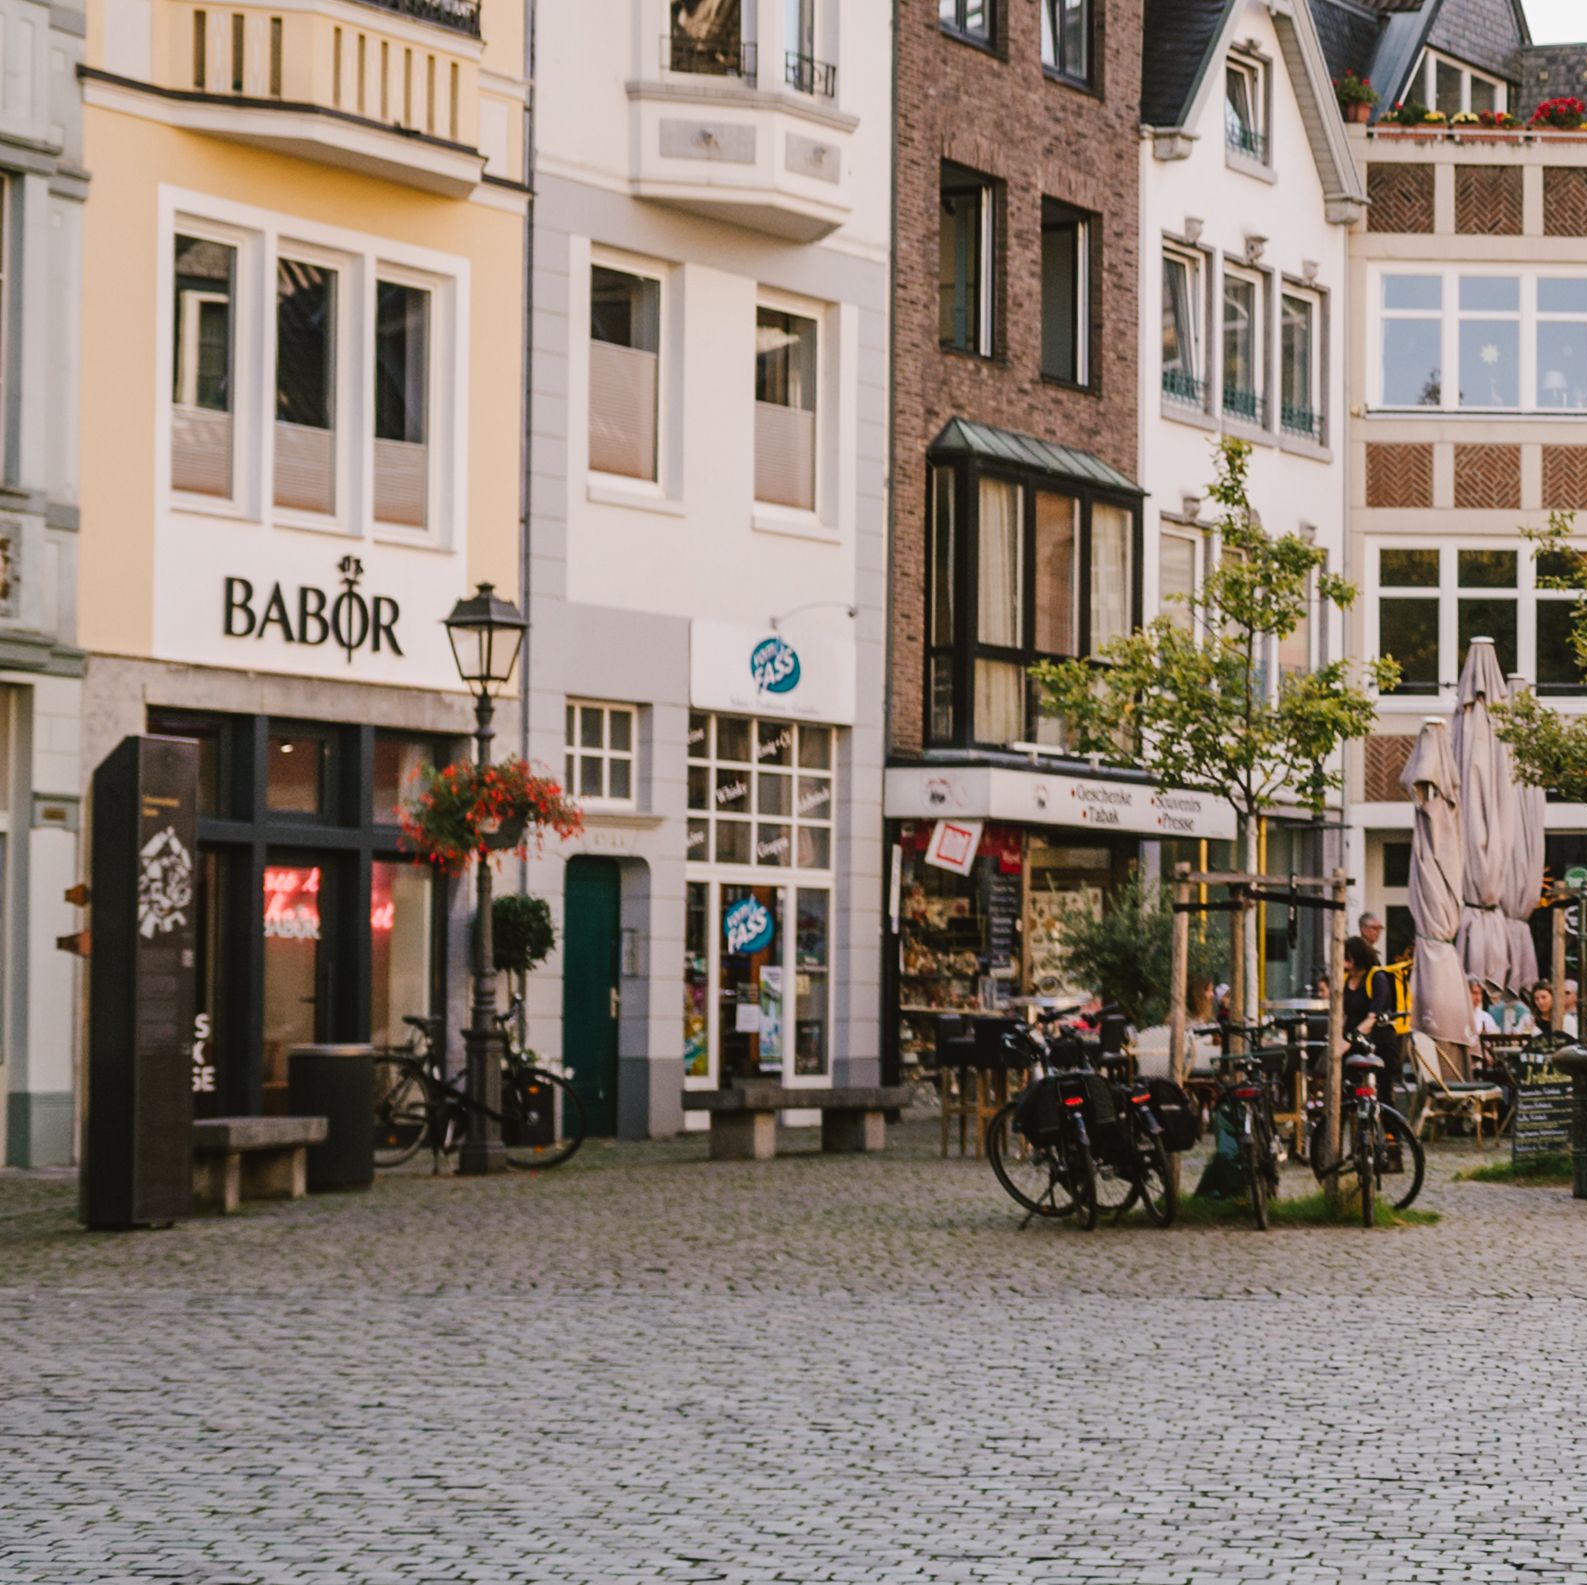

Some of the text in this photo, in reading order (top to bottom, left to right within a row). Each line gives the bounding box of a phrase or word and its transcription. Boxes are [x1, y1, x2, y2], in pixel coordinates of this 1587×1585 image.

[224, 576, 404, 664] BABOR
[753, 648, 795, 694] FASS
[1076, 783, 1133, 806] Geschenke
[1089, 806, 1120, 825] Tabak
[1162, 813, 1195, 832] Presse
[727, 906, 768, 955] FASS
